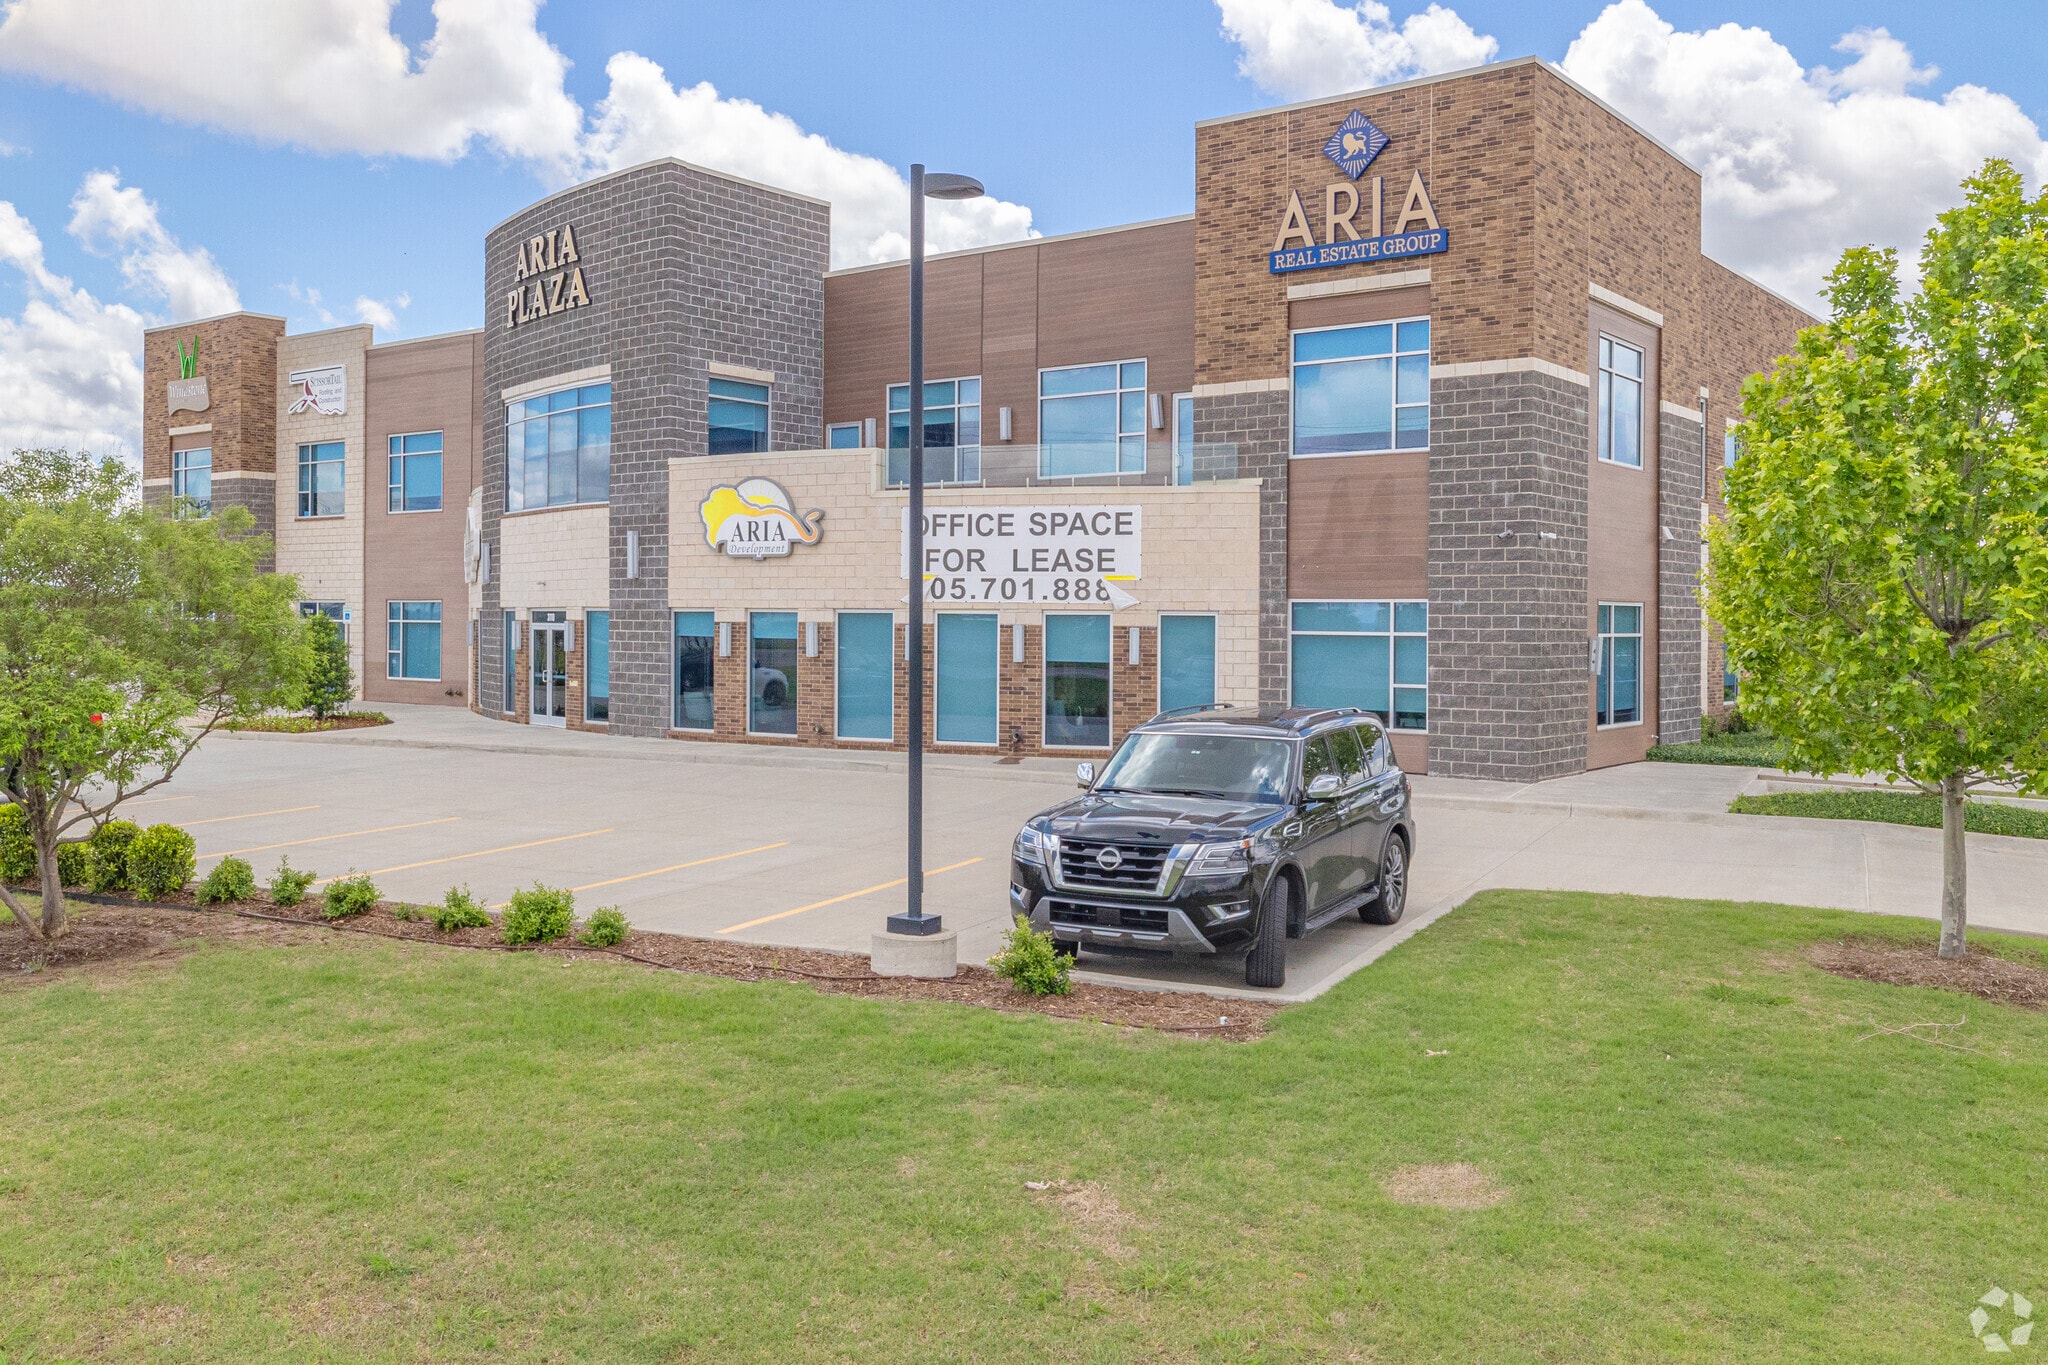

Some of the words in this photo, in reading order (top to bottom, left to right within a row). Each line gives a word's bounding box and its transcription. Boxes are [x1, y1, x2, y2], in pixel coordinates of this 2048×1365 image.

[1273, 168, 1441, 252] ARIA
[515, 224, 580, 283] ARIA
[1274, 252, 1317, 270] REAL
[1319, 243, 1379, 264] ESTATE
[1382, 233, 1442, 255] GROUP
[507, 266, 591, 328] PLAZA
[731, 520, 786, 542] ARIA
[1028, 511, 1134, 536] SPACE
[729, 543, 785, 557] Development
[925, 548, 986, 573] FOR
[1012, 548, 1116, 573] LEASE
